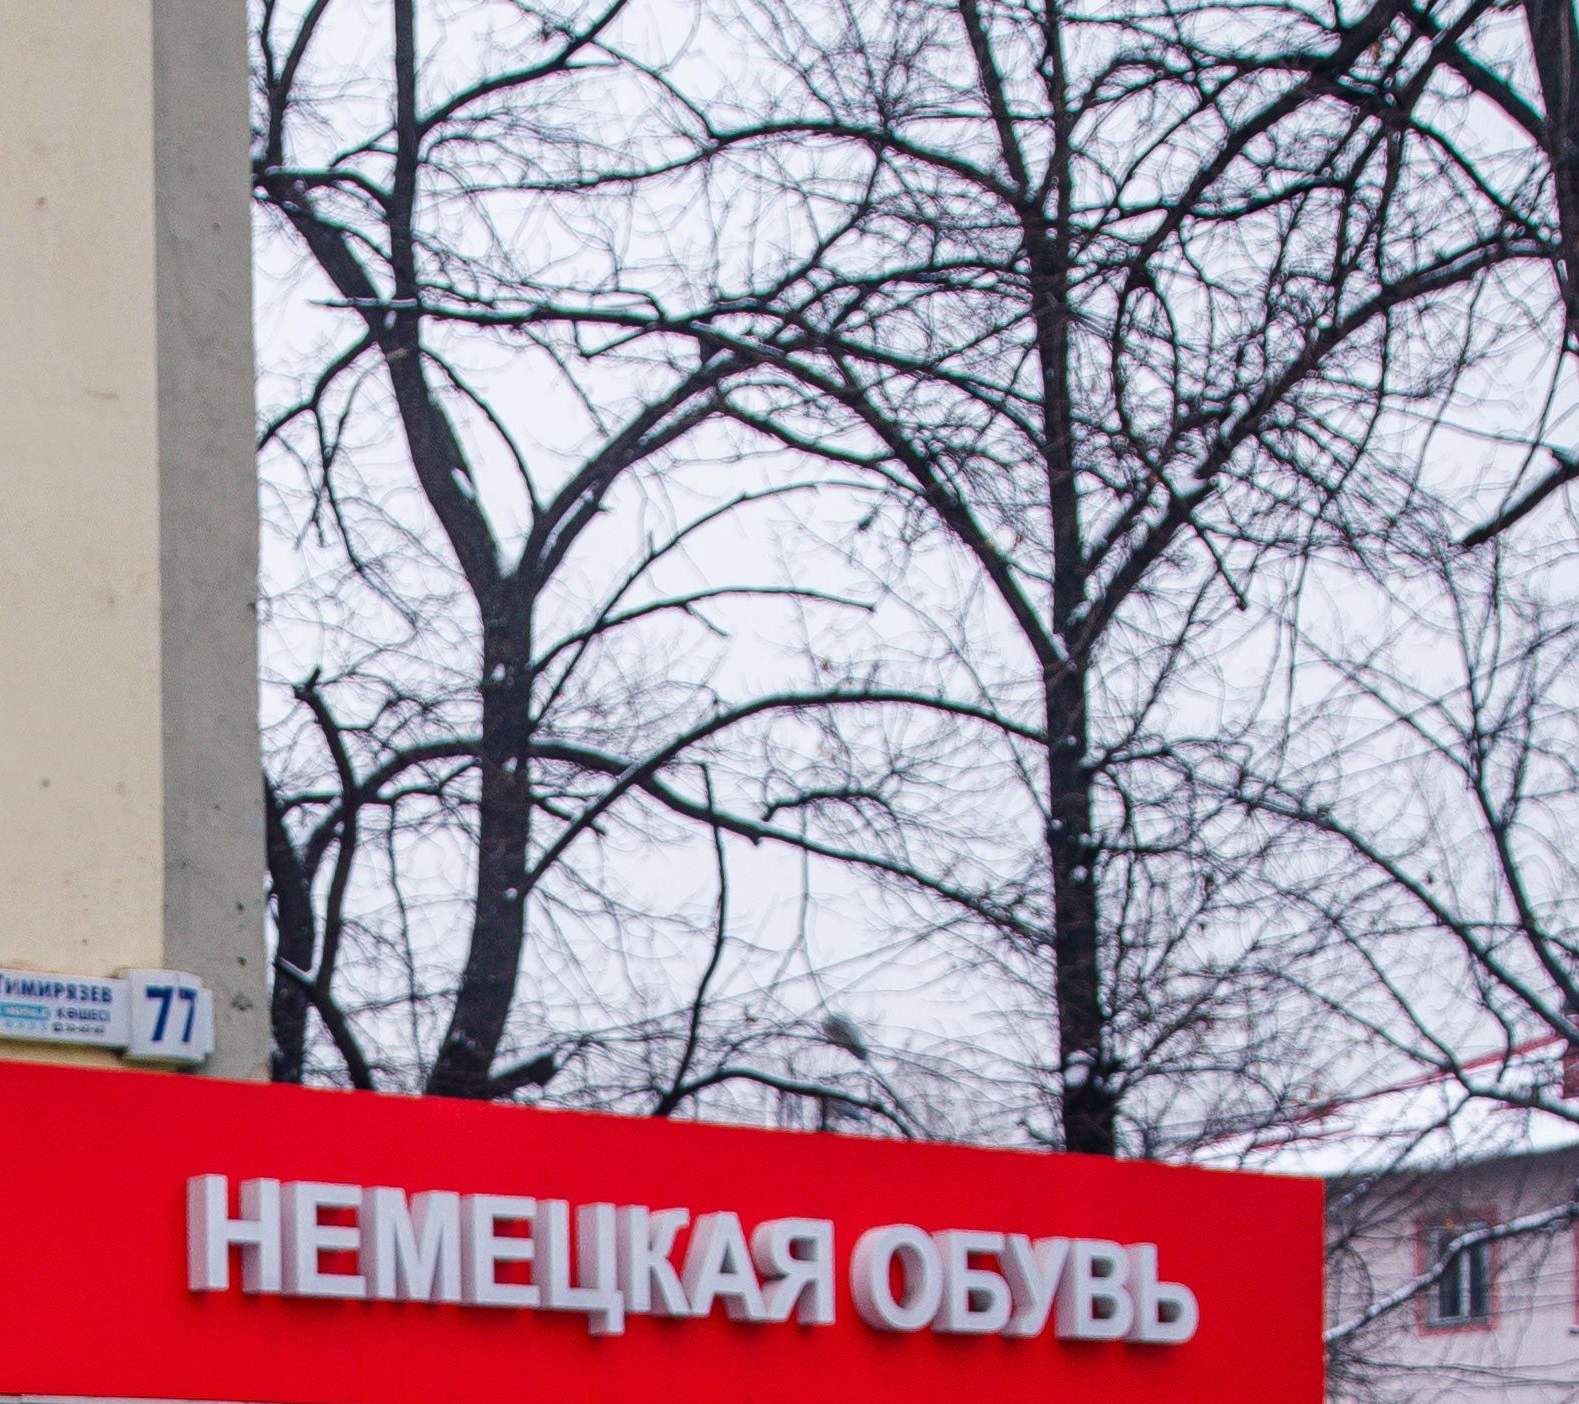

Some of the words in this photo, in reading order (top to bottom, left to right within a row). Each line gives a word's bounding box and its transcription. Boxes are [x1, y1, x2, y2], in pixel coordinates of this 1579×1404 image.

[146, 985, 199, 1043] 77
[187, 1173, 837, 1336] НЕМЕЦКАЯ
[851, 1222, 1200, 1346] ОБУВЬ
